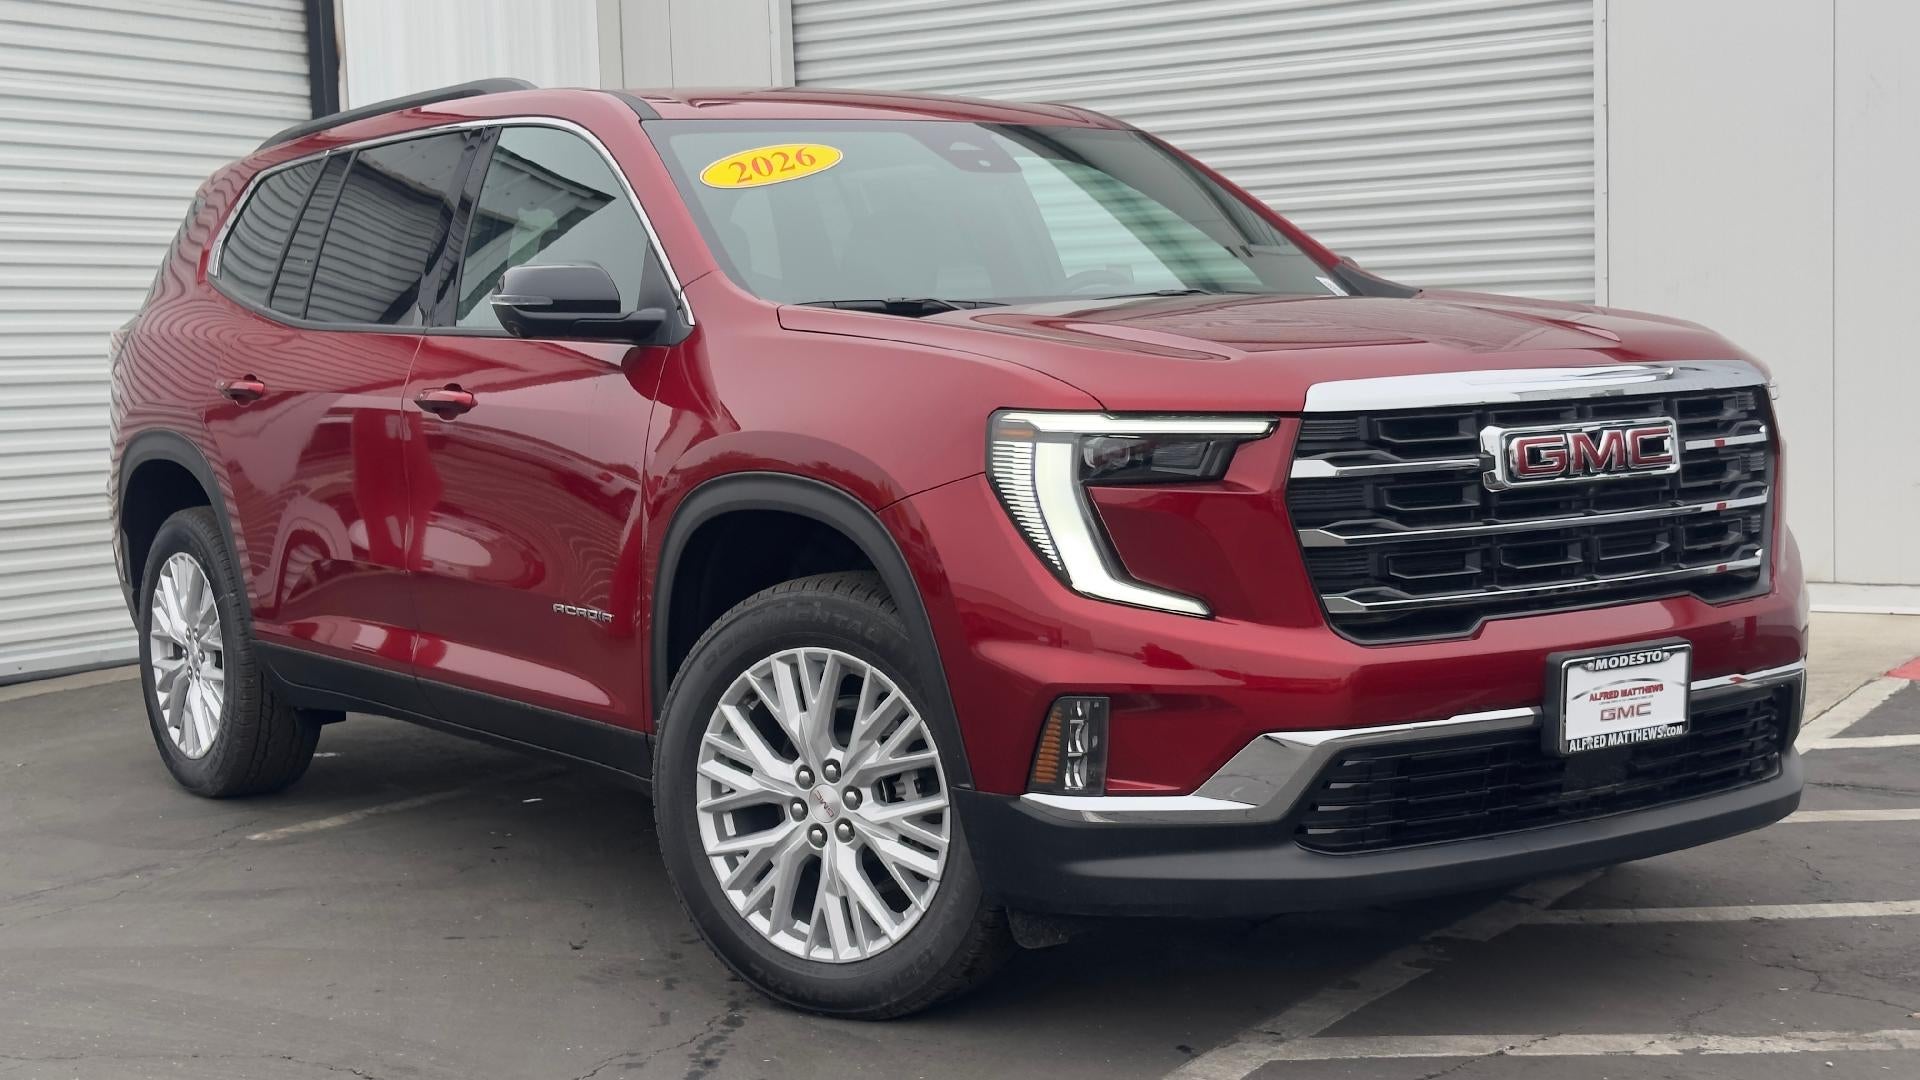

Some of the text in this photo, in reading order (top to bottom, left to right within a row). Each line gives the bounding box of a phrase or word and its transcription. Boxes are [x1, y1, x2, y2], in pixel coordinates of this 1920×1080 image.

[728, 147, 816, 184] 2026
[1509, 426, 1673, 479] GMC
[552, 603, 614, 623] ACADIA
[1595, 651, 1662, 670] MODESTO
[1589, 690, 1619, 702] ALFRED
[1621, 684, 1664, 697] MATTHEWS
[1600, 702, 1651, 721] GMC
[1569, 734, 1608, 752] ALFRED
